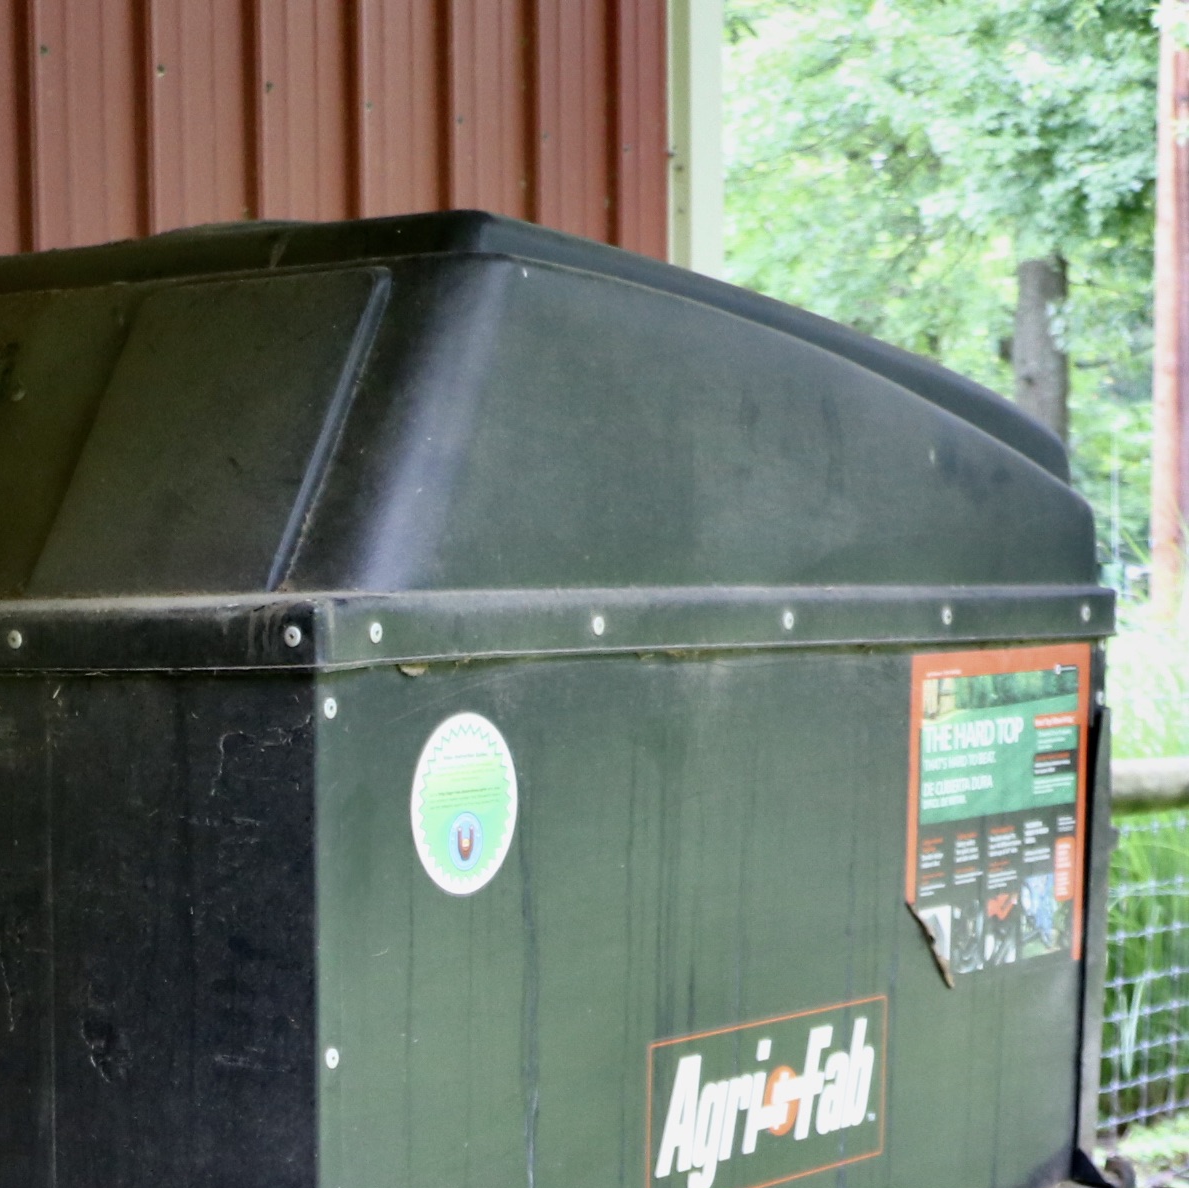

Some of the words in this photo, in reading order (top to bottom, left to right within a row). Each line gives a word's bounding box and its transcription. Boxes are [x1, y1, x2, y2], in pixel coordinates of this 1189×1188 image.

[923, 725, 952, 753] THE
[954, 720, 995, 749] HARD
[994, 716, 1024, 744] TOP
